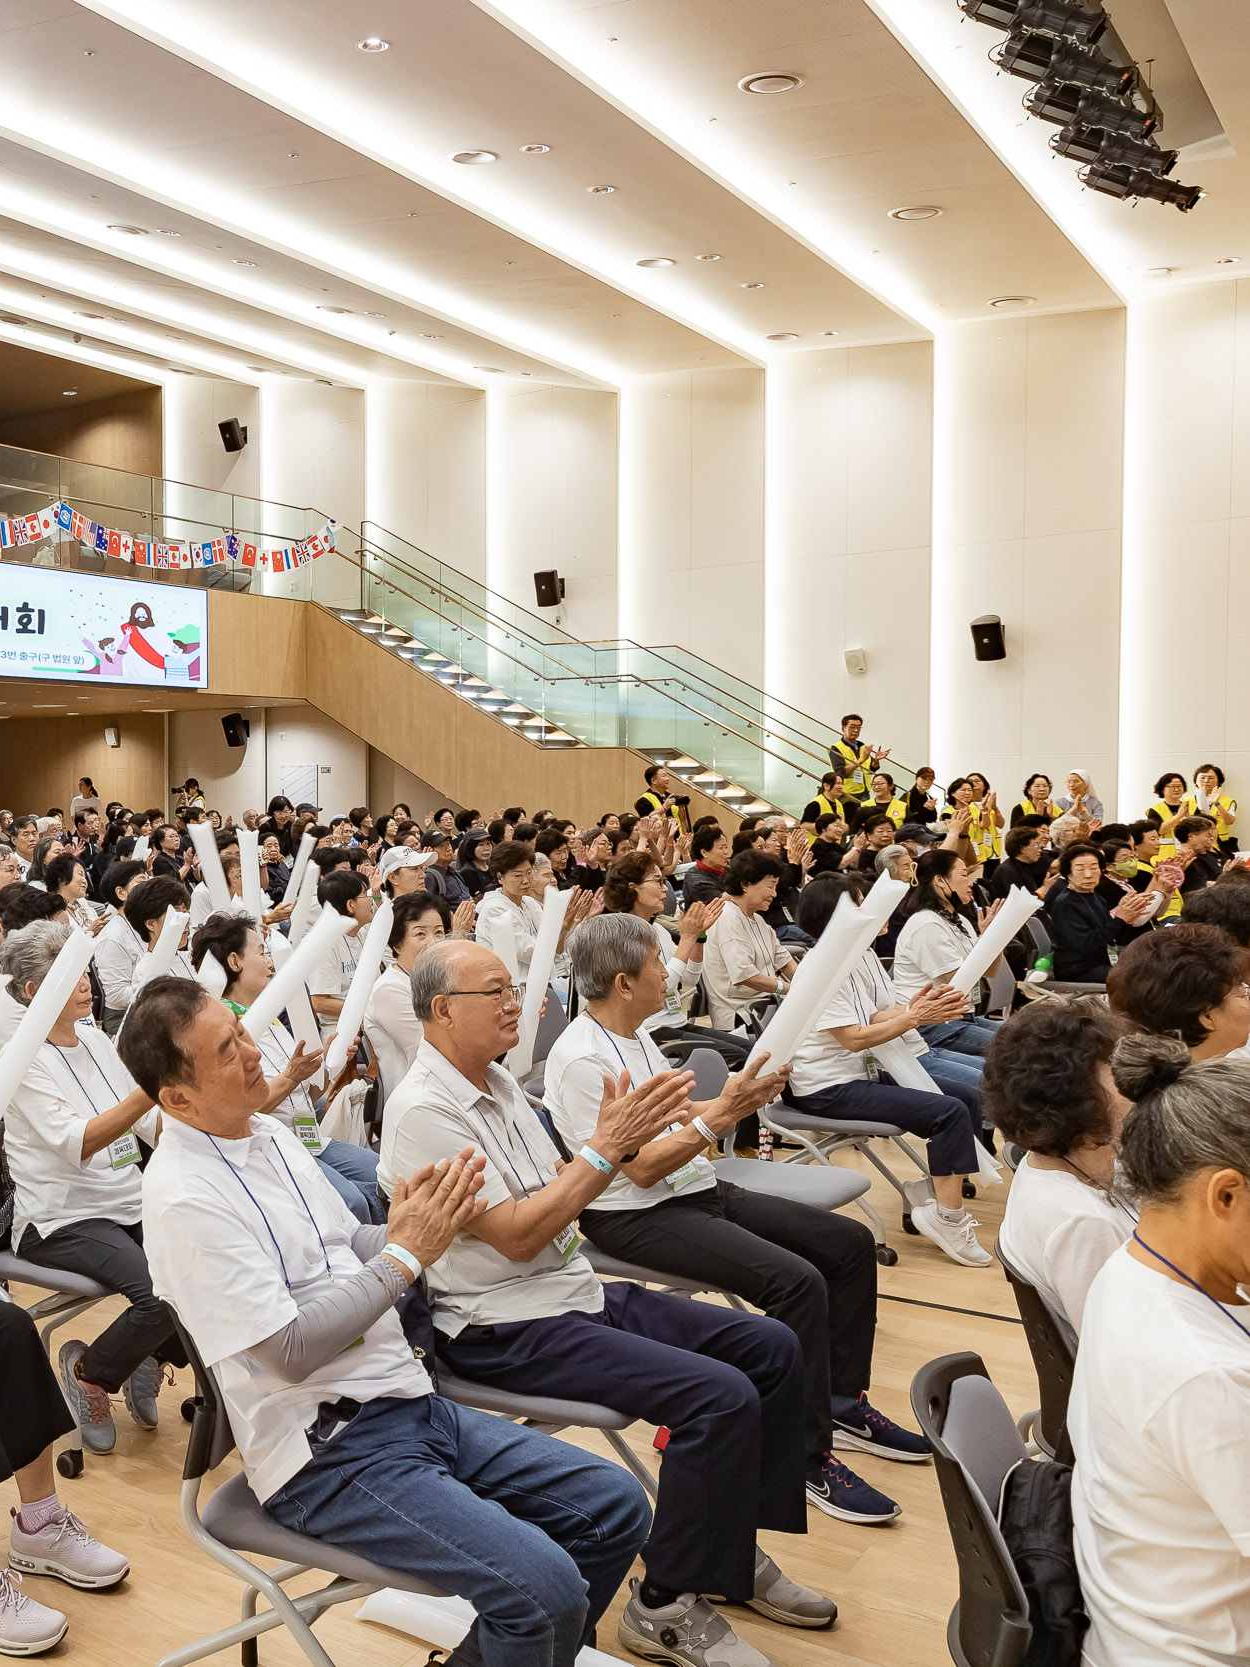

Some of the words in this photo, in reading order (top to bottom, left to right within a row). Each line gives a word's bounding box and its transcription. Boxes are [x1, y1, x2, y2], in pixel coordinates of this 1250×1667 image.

[0, 650, 17, 661] 3번
[52, 653, 71, 665] 법원
[72, 655, 85, 666] 앞)
